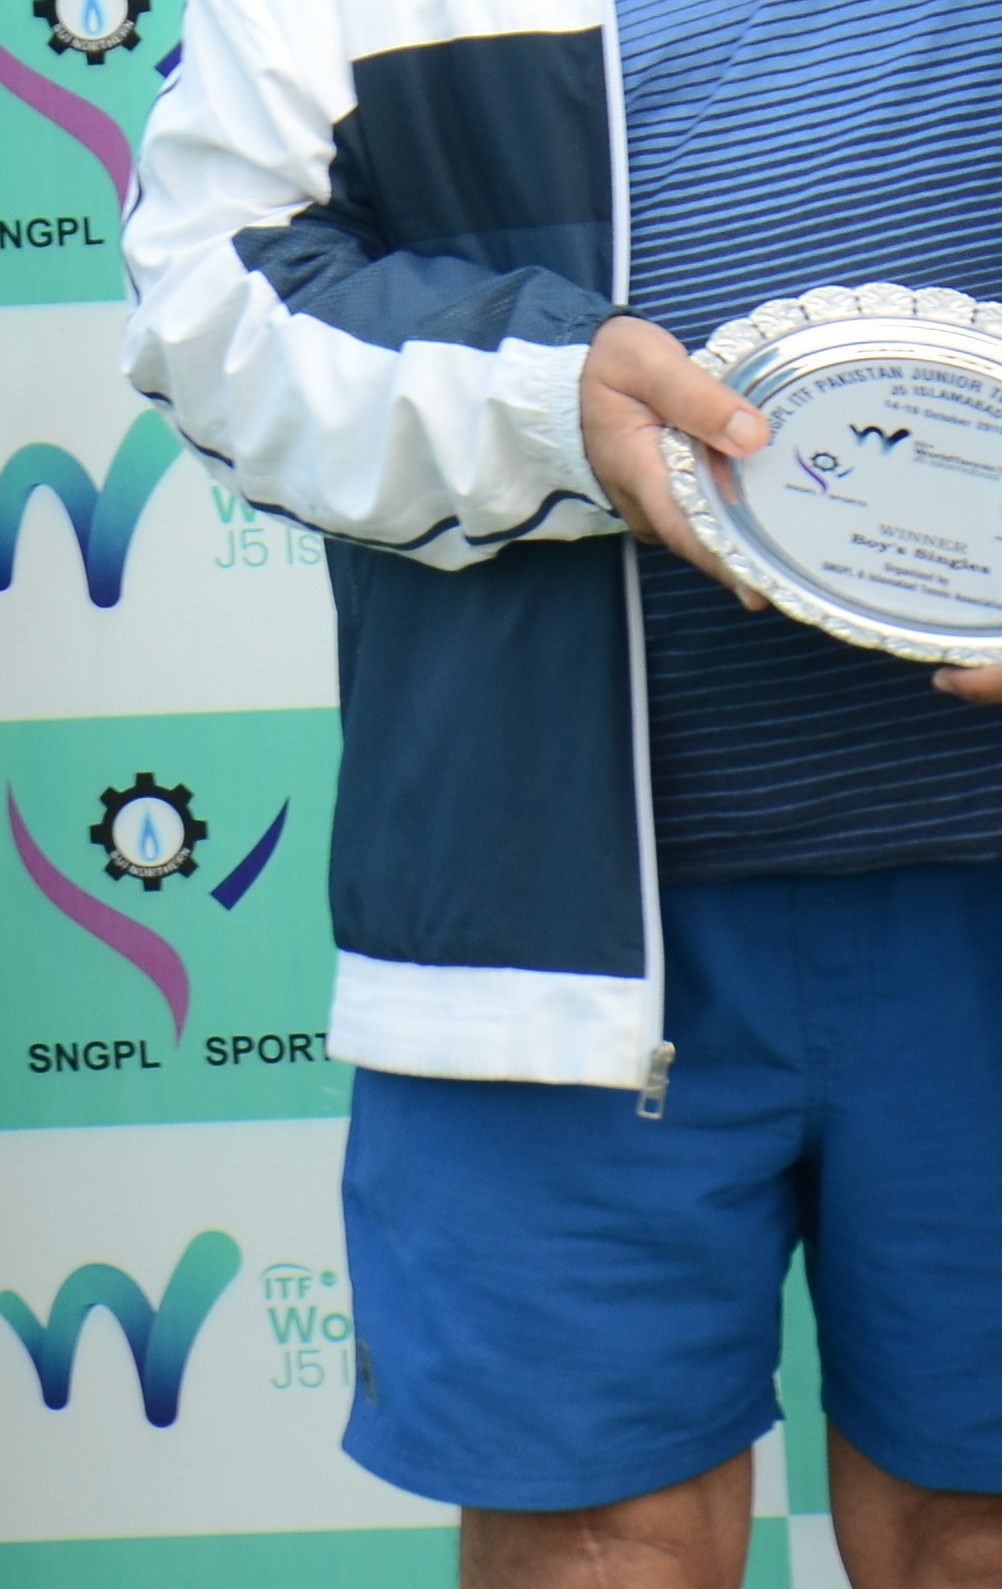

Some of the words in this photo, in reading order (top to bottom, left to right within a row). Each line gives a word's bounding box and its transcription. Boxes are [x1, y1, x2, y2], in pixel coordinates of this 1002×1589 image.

[788, 385, 815, 409] ITF
[814, 365, 904, 394] PAKISTAN
[911, 367, 984, 394] JUNIOR
[213, 527, 269, 568] J5
[877, 523, 969, 554] WINNER
[28, 1039, 161, 1073] SNGPL
[265, 1276, 312, 1300] ITF
[270, 1350, 325, 1389] J5
